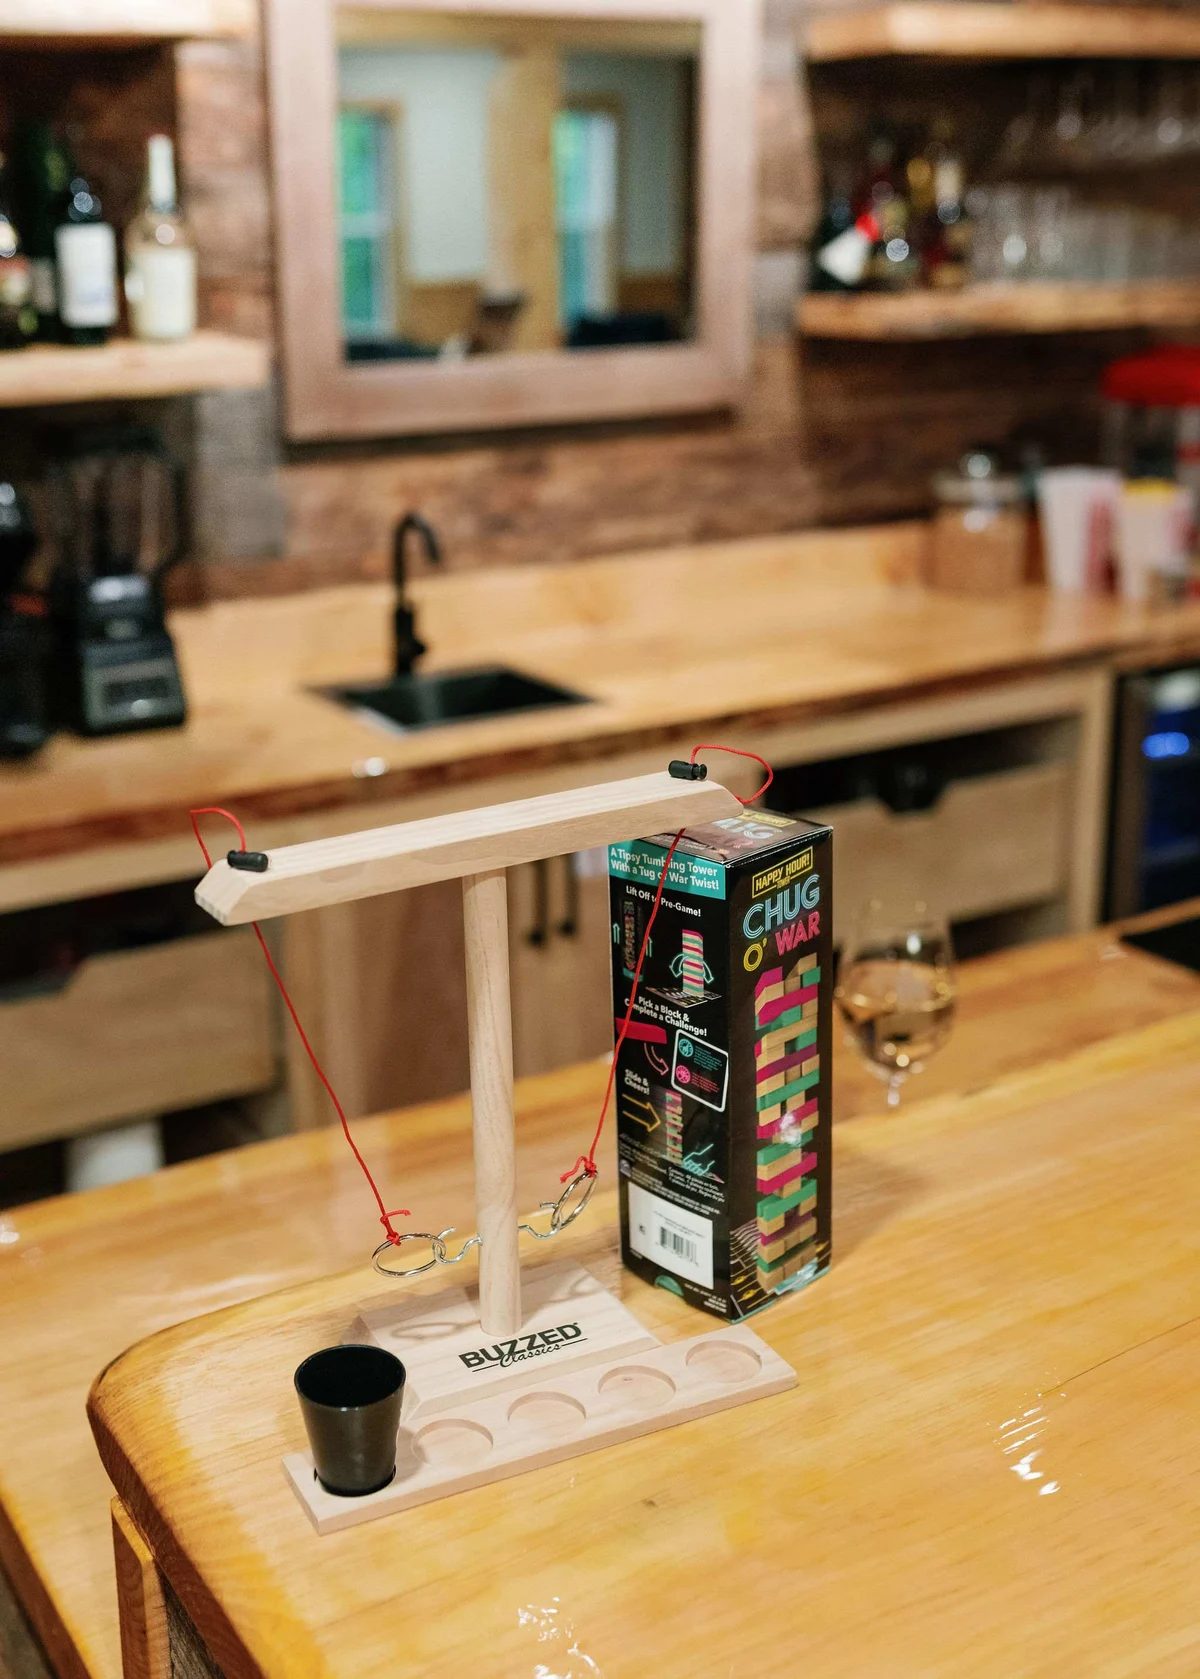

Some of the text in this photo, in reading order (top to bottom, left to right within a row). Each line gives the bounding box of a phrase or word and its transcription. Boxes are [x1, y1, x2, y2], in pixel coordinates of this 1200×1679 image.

[610, 859, 630, 873] With
[632, 866, 638, 874] a
[639, 865, 656, 881] Tug
[669, 871, 689, 885] War
[689, 876, 719, 890] Twist!
[611, 847, 617, 857] A
[617, 848, 641, 864] Tipsy
[687, 861, 718, 877] Tower
[755, 853, 810, 892] HAPPY HOUR!
[626, 885, 637, 897] Lift
[638, 890, 650, 901] Off
[660, 897, 702, 917] Pre-Game!
[743, 874, 820, 939] CHUG
[775, 911, 820, 956] WAR
[624, 998, 707, 1037] Cmplete a Challenge!
[638, 996, 654, 1009] Pick
[660, 1005, 681, 1019] Block
[683, 1013, 690, 1022] &
[458, 1323, 582, 1368] BUZZED
[499, 1343, 562, 1368] Classics
